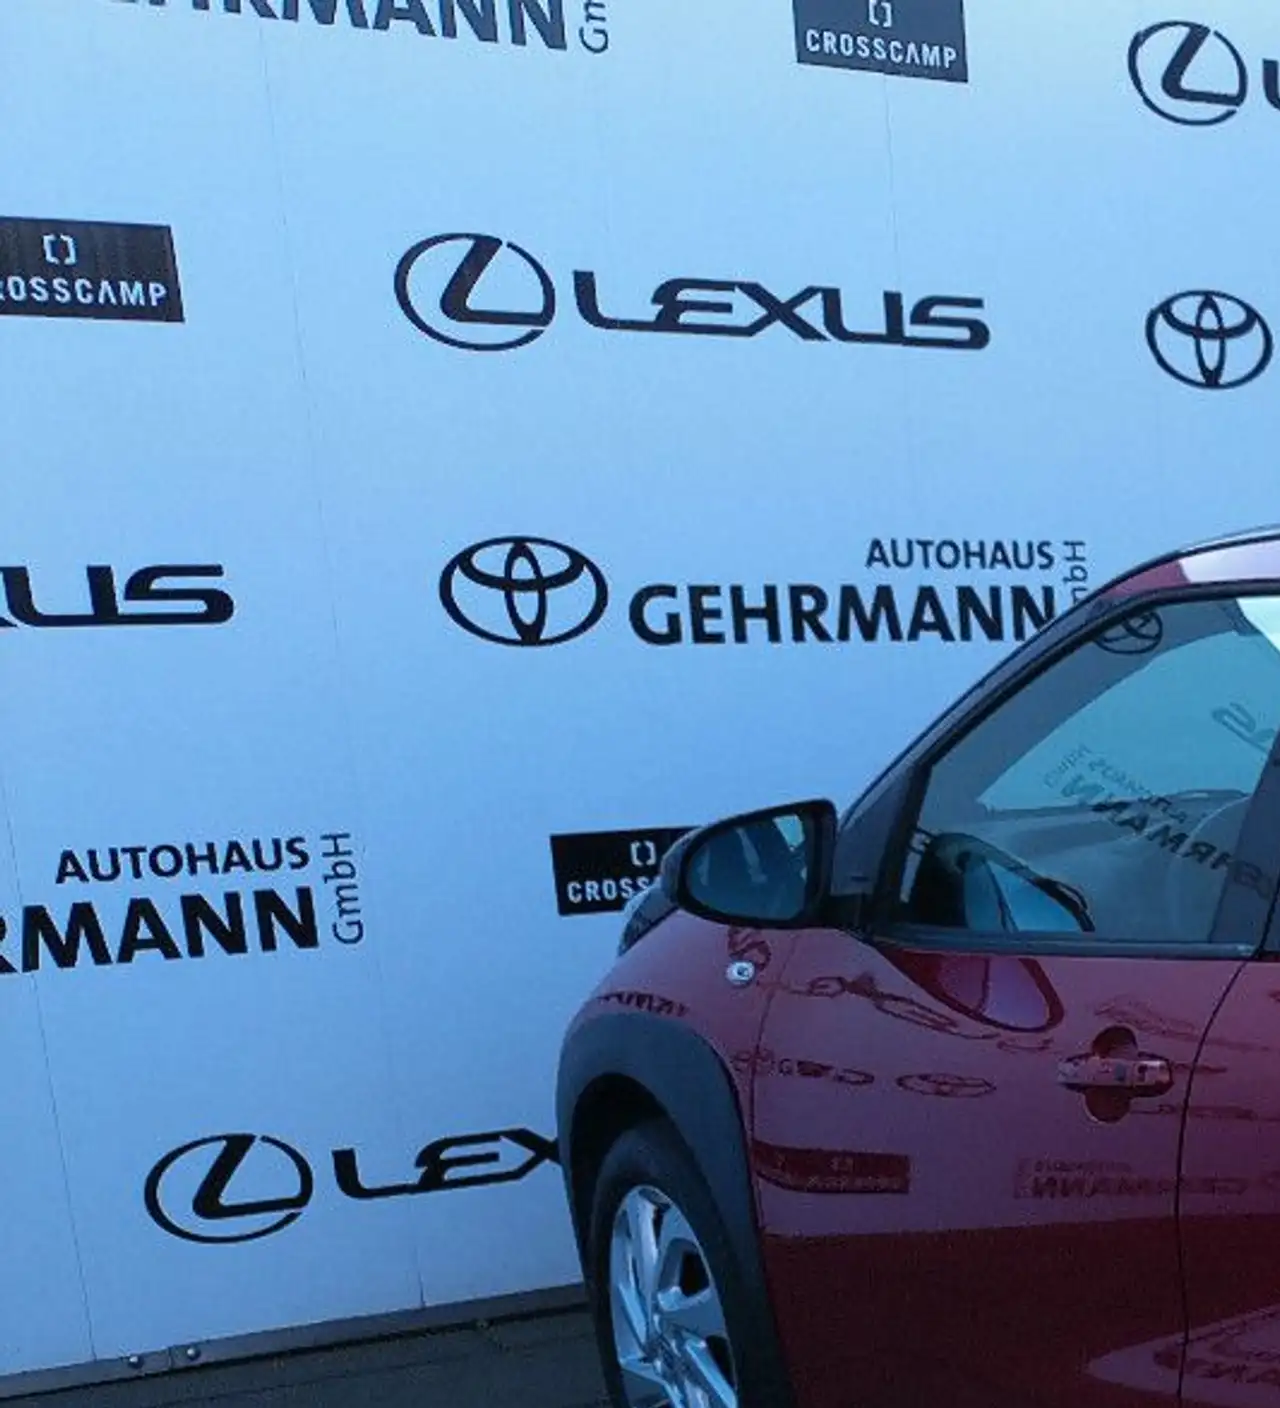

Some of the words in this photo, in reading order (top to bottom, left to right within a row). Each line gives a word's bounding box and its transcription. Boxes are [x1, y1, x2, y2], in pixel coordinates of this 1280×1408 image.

[805, 30, 957, 69] CROSSCAMP
[572, 270, 990, 350] LEXUS
[864, 538, 1055, 570] AUTOHAUS
[0, 565, 234, 628] US
[628, 584, 1056, 646] GEHRMANN
[56, 836, 311, 884] AUTOHAUS
[320, 832, 364, 945] GmbH
